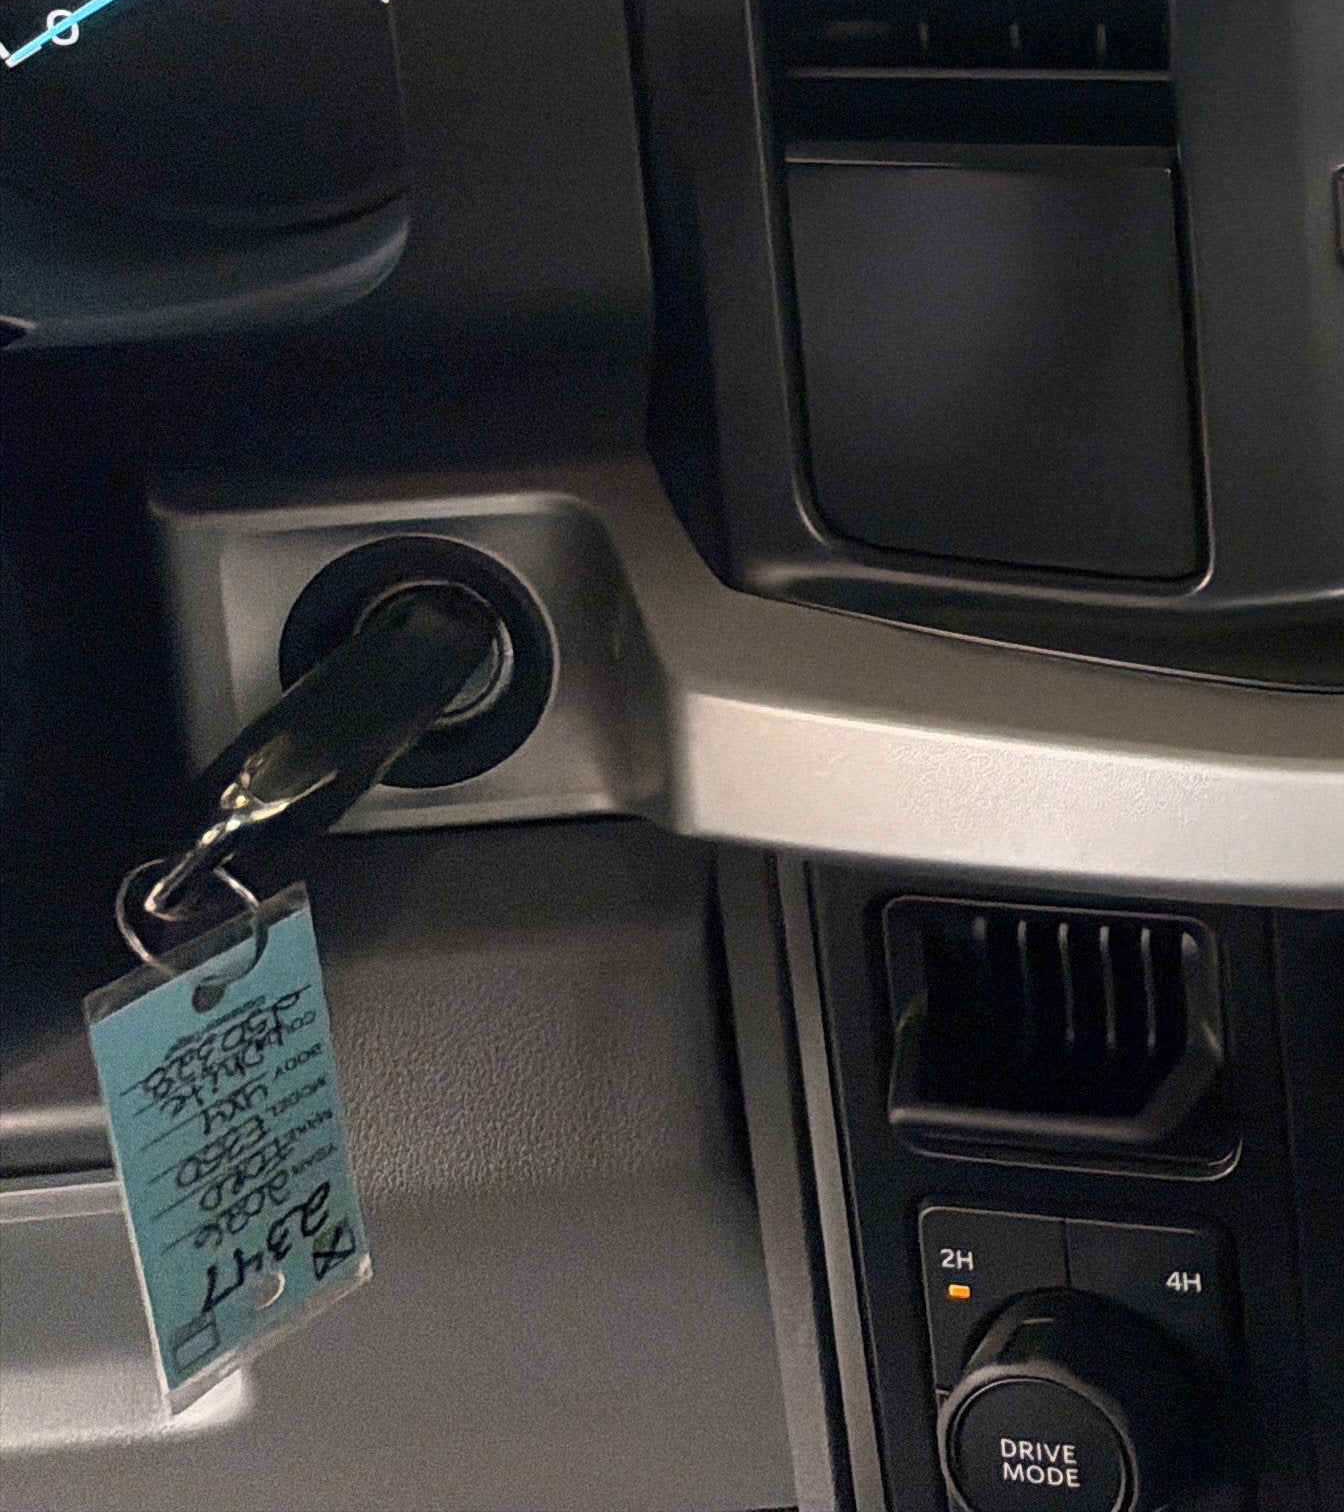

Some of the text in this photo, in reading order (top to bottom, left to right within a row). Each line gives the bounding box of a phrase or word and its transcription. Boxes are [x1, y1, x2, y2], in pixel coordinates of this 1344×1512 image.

[46, 9, 80, 46] 0
[201, 1181, 330, 1314] 2347
[940, 1248, 1202, 1292] 2H 4H
[1000, 1437, 1078, 1466] DRIVE
[1002, 1460, 1081, 1488] MODE
